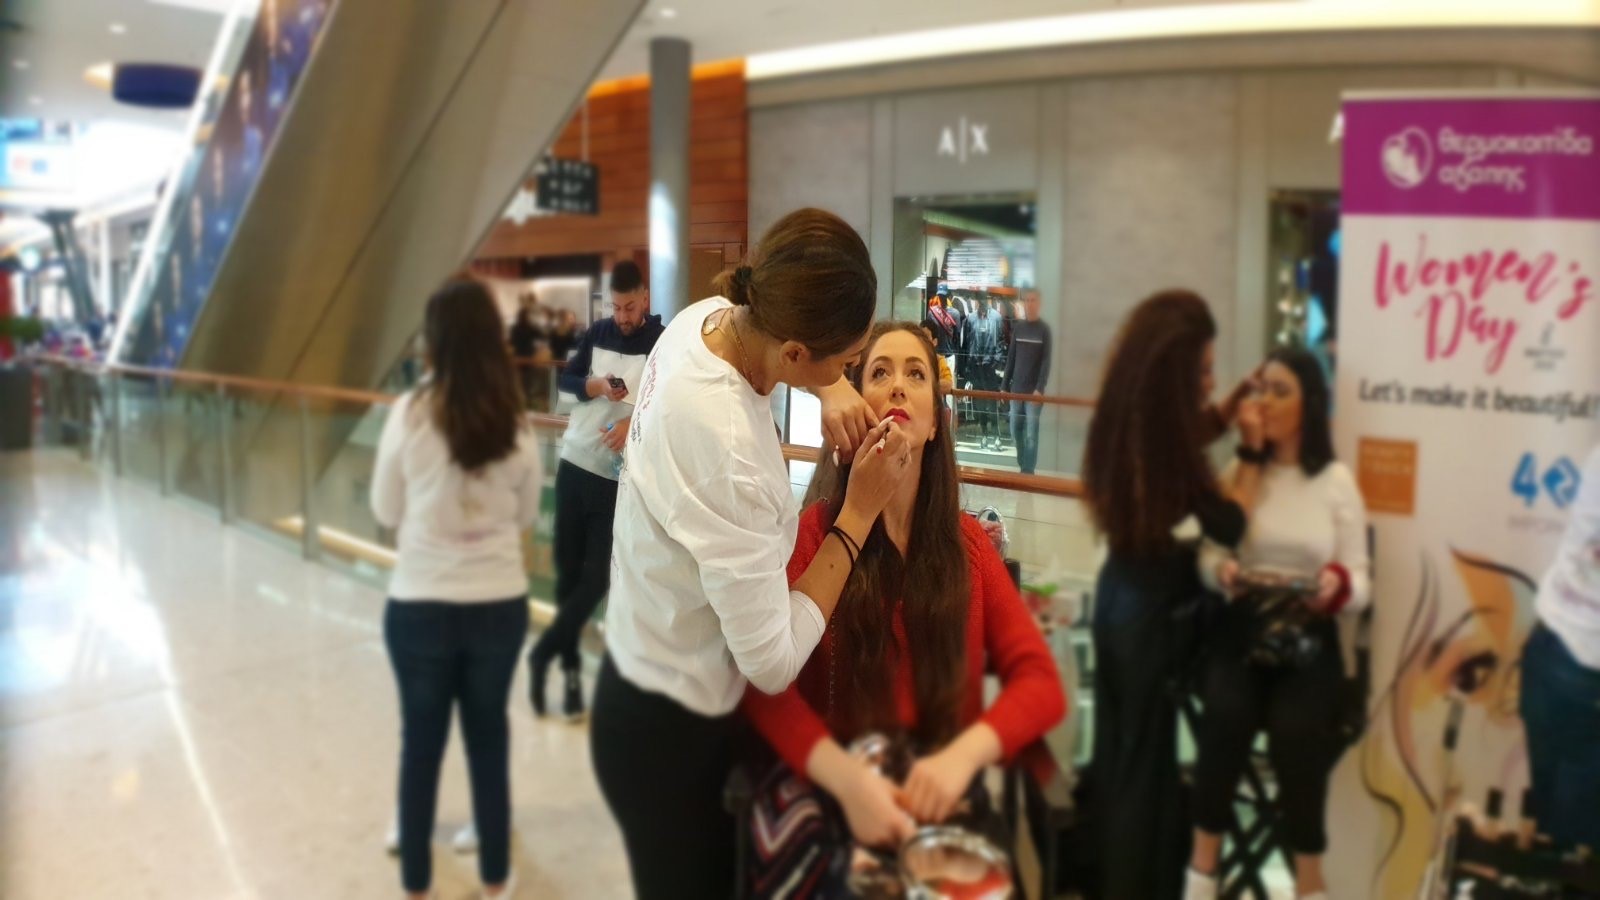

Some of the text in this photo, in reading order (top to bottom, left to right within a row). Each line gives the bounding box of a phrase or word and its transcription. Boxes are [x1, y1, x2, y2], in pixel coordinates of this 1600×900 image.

[1374, 234, 1594, 320] Women's
[1416, 290, 1518, 375] Day
[1358, 378, 1406, 403] Let's
[1410, 384, 1469, 410] make
[1472, 386, 1489, 411] it
